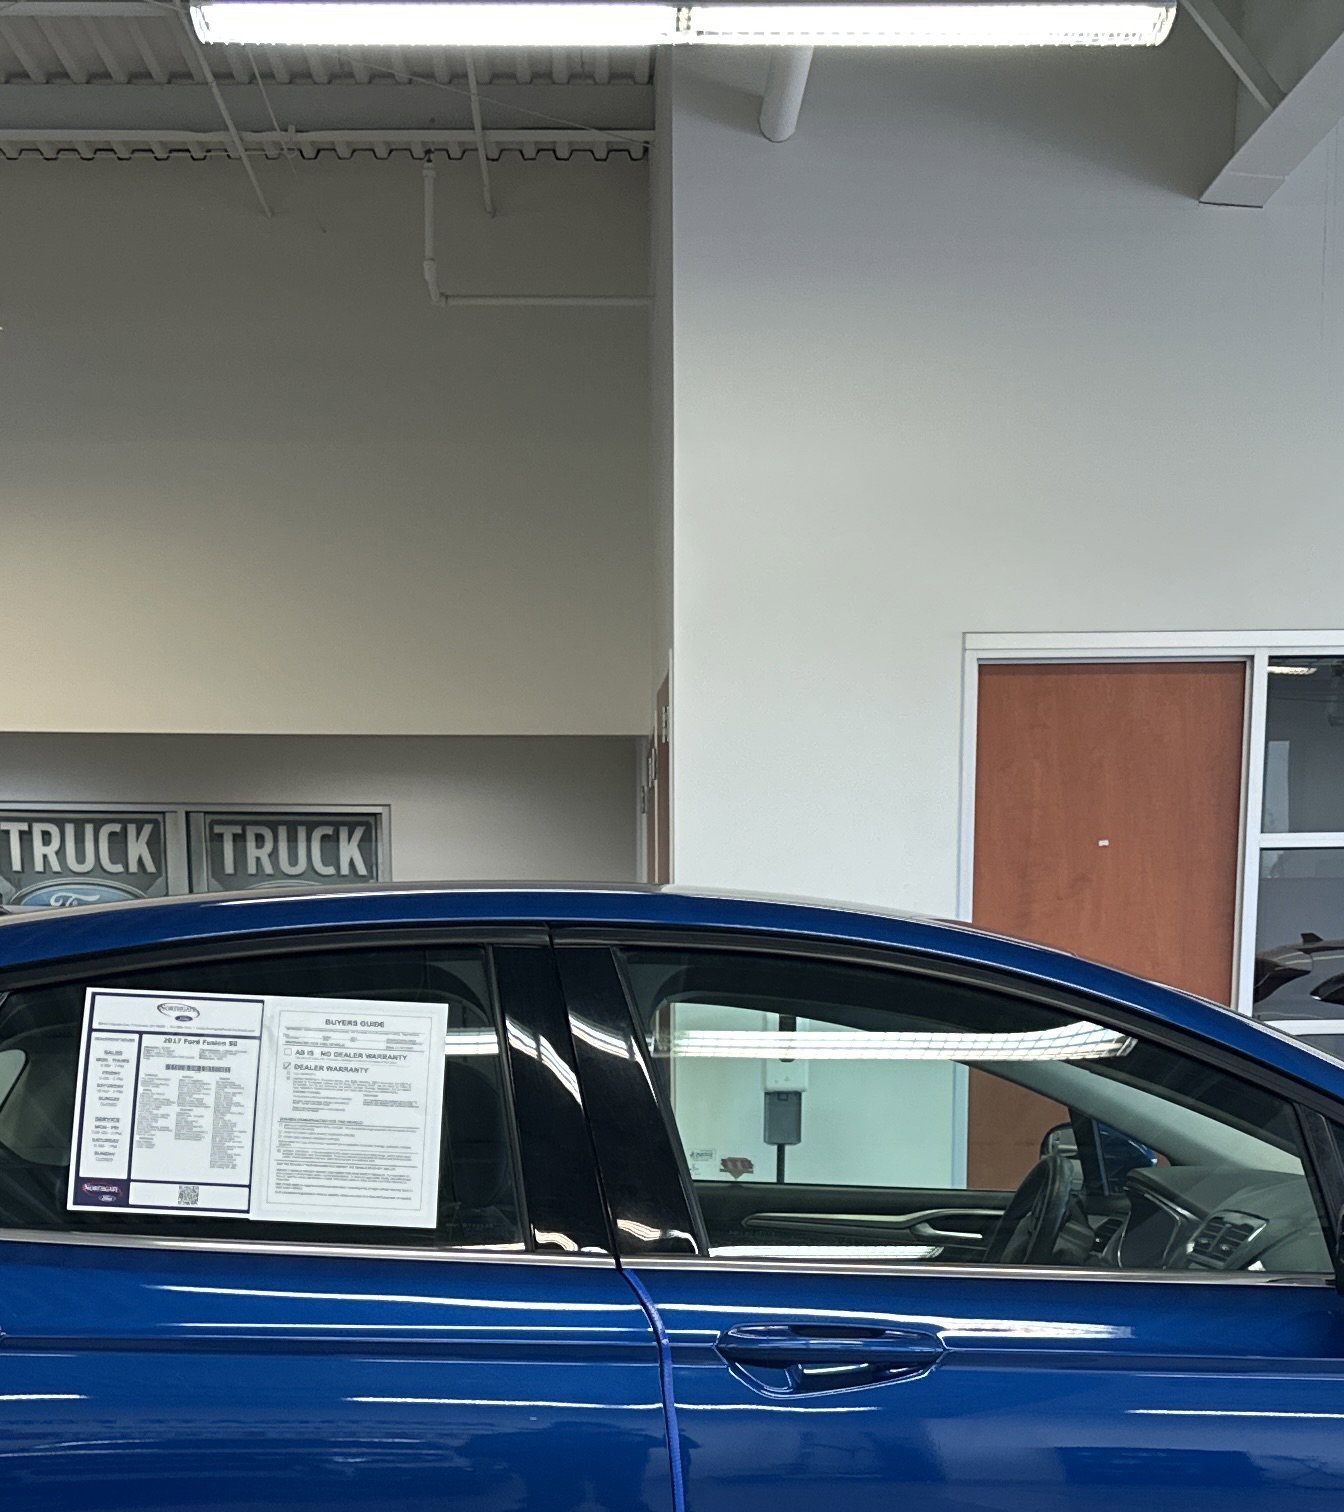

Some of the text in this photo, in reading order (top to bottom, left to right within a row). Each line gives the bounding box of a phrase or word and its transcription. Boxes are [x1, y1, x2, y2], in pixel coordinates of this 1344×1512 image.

[0, 822, 157, 874] TRUCK
[213, 825, 369, 877] TRUCK
[325, 1018, 385, 1029] BUYERS GUIDE
[364, 1053, 408, 1061] WARRANTY
[294, 1063, 370, 1074] DEALER WARRANTY
